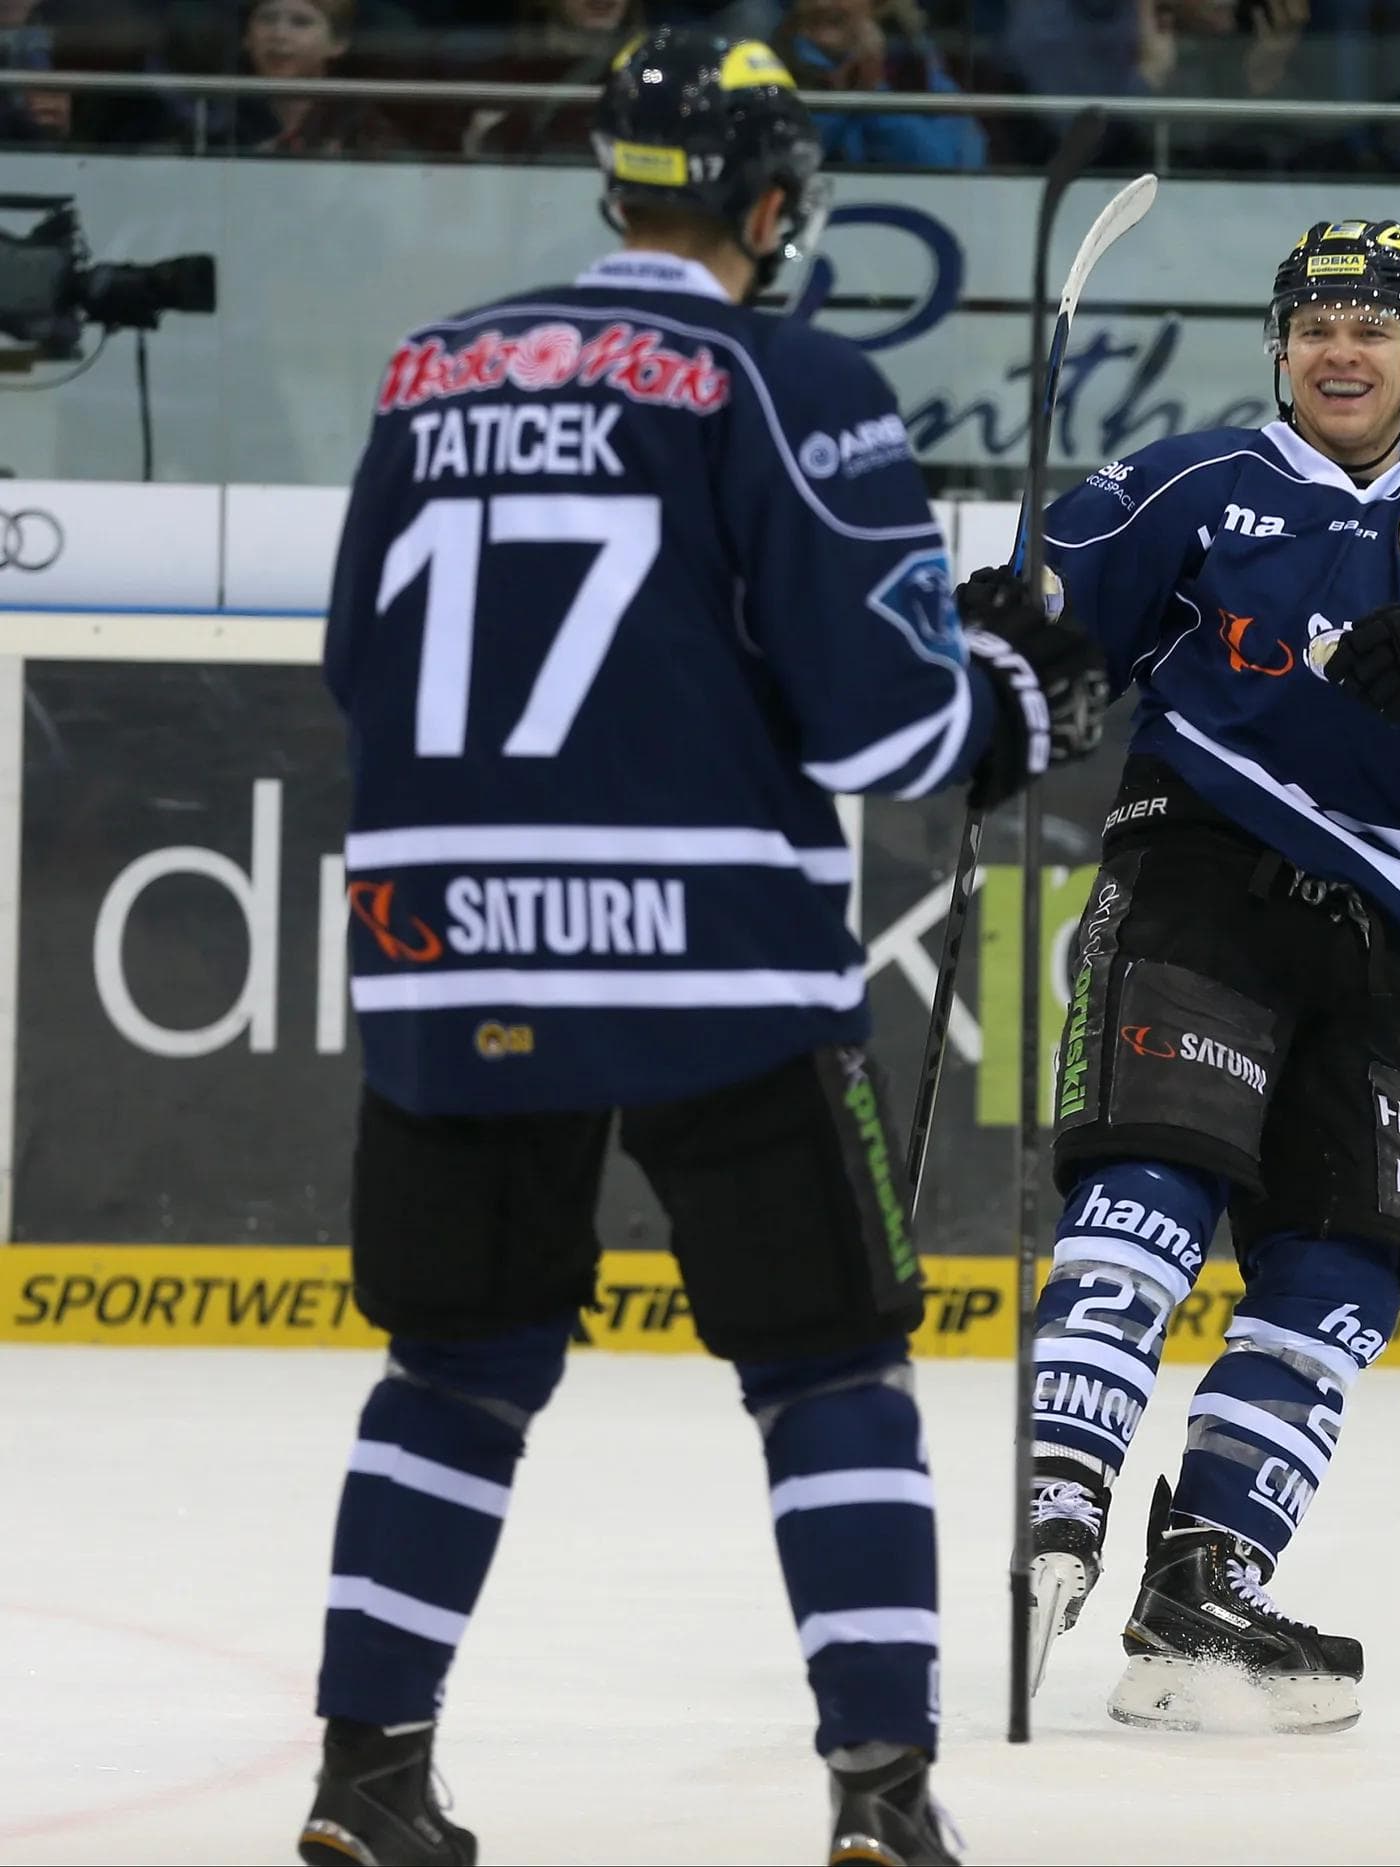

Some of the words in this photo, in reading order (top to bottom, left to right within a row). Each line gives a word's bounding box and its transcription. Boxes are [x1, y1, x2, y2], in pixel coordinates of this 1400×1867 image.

[1311, 255, 1360, 266] EDEKA
[410, 402, 625, 482] TATICEK
[376, 494, 661, 758] 17
[445, 876, 687, 956] SATURN
[1180, 1032, 1267, 1095] SATURN
[15, 1273, 354, 1328] SPORTWET
[1032, 1371, 1143, 1442] CINQU
[1307, 1376, 1345, 1451] 2
